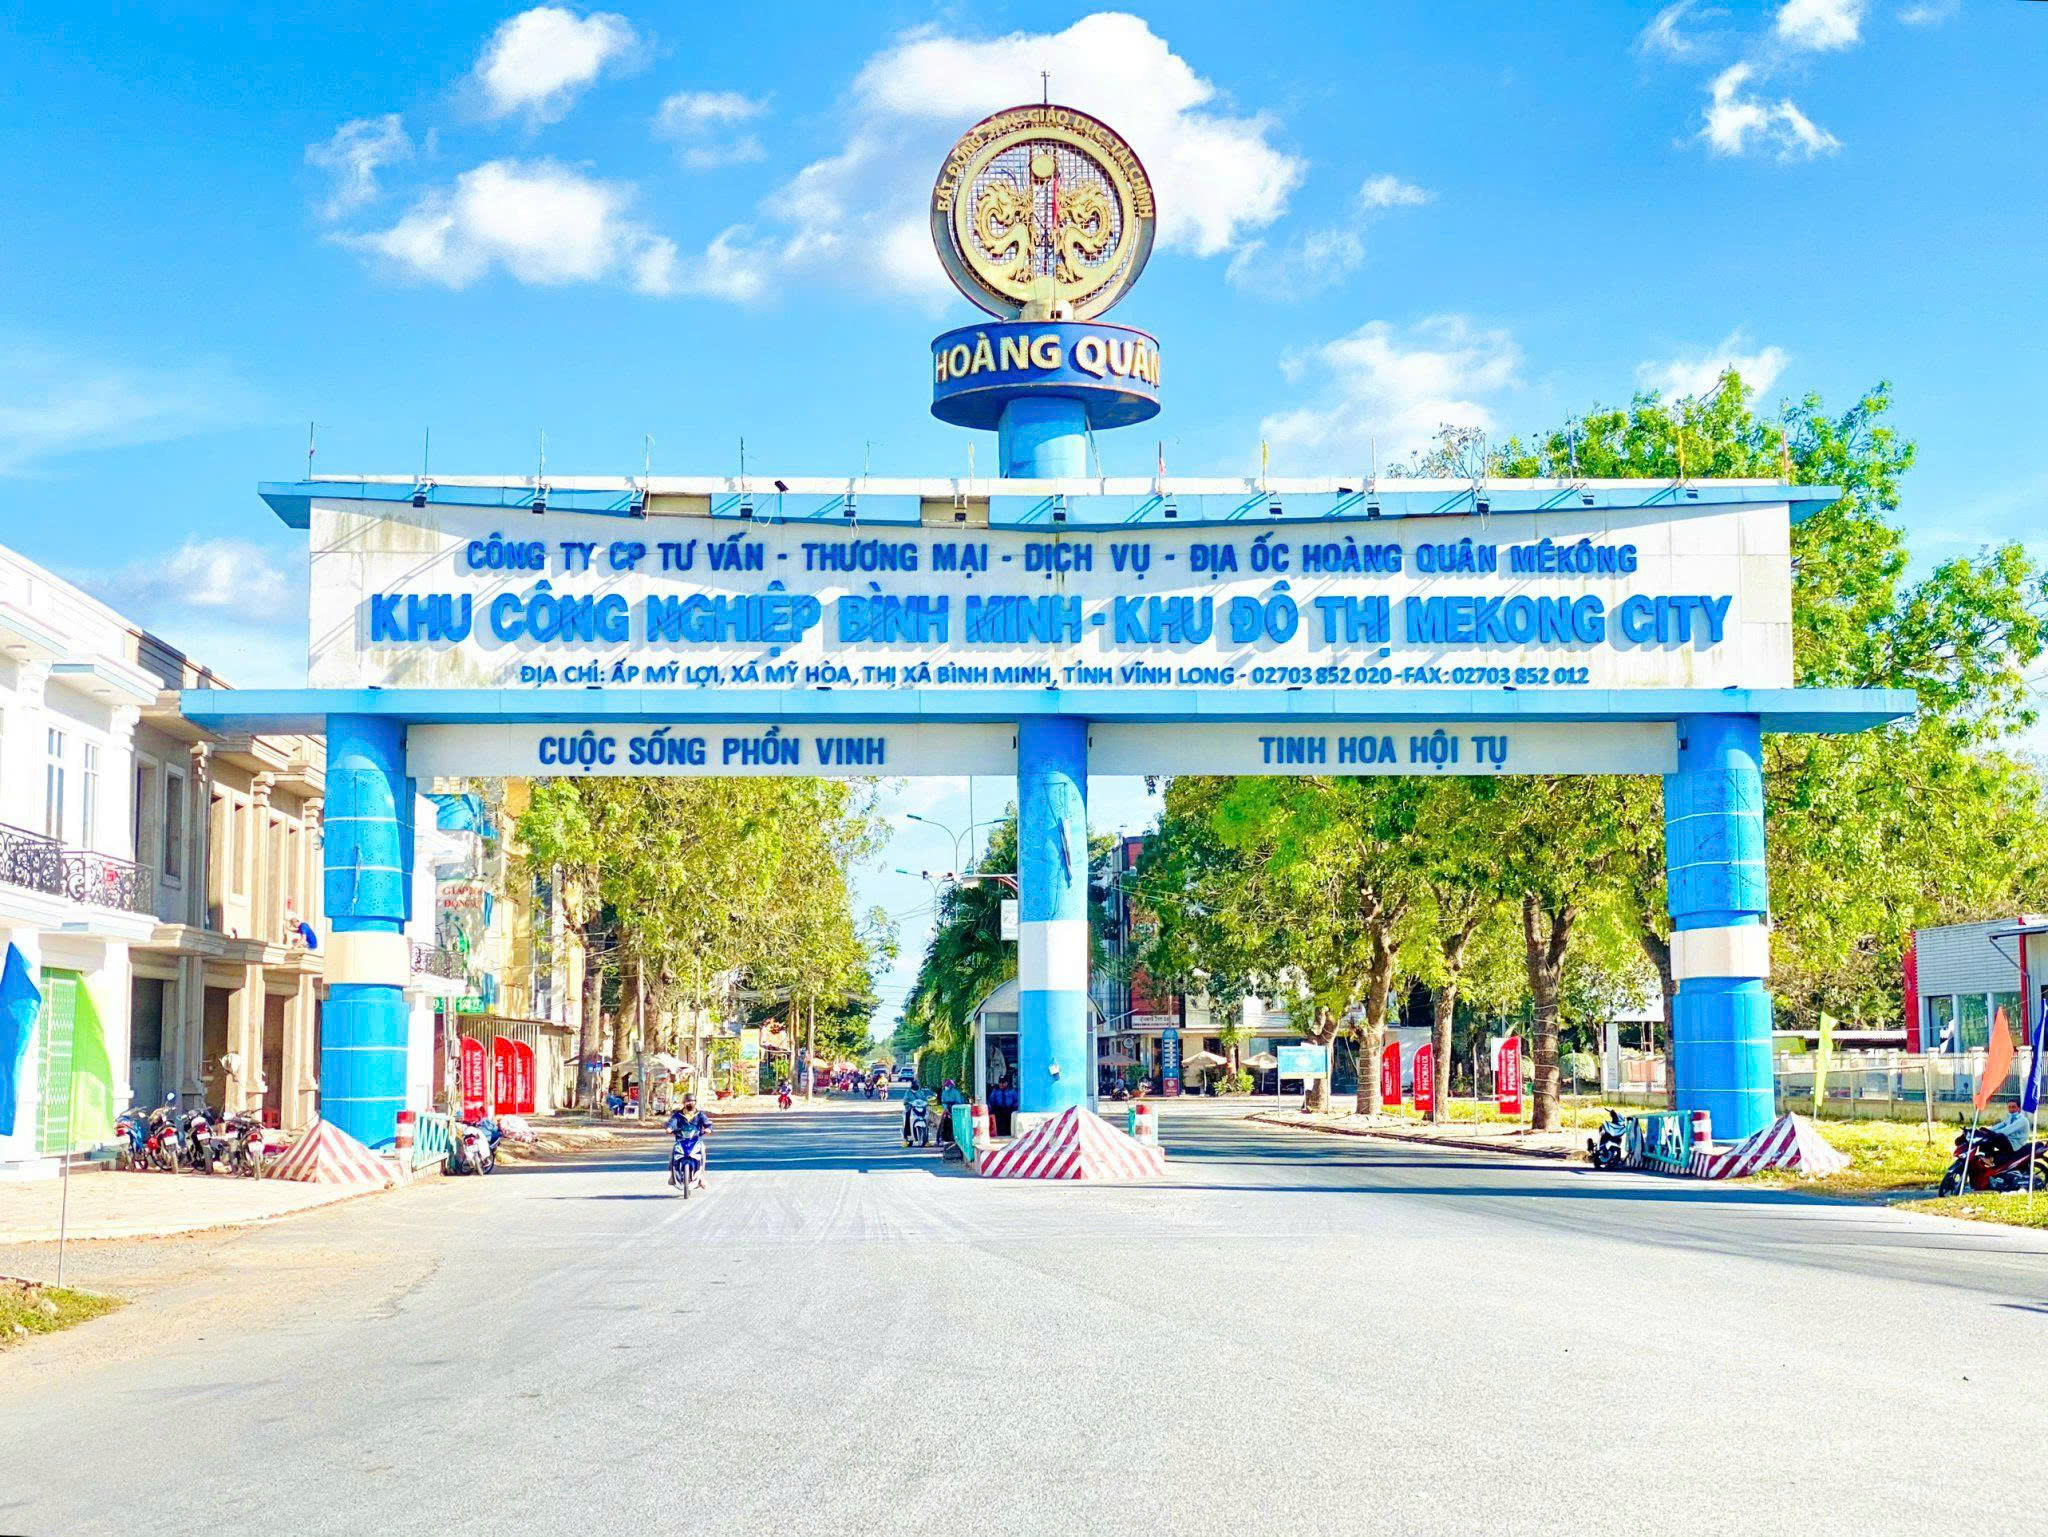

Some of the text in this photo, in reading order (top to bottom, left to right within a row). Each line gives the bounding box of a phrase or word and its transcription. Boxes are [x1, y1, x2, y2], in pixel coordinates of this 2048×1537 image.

[935, 331, 1160, 387] HOÀNG QUÂN
[467, 532, 546, 571] CÔNG
[560, 542, 597, 571] TY
[609, 541, 646, 571] CP
[657, 539, 697, 571] TƯ
[707, 532, 765, 572] VẤN
[801, 543, 919, 574] THƯƠNG
[932, 543, 989, 580] MẠI
[1024, 542, 1093, 580] DỊCH
[1110, 543, 1151, 580] VỤ
[1190, 543, 1239, 581] ĐỊA
[1250, 531, 1290, 573] ỐC
[1302, 535, 1403, 573] HOÀNG
[1416, 537, 1498, 574] QUÂN
[1511, 537, 1638, 573] MÊKÔNG
[371, 594, 473, 643] KHU
[489, 580, 631, 643] CÔNG
[646, 580, 822, 656] NGHIỆP
[839, 581, 950, 644] BÌNH
[965, 594, 1083, 644] MINH
[1114, 595, 1213, 644] KHU
[1229, 580, 1299, 643] ĐÔ
[1315, 595, 1391, 657] THỊ
[1406, 594, 1606, 643] MEKONG
[1621, 594, 1732, 643] CITY
[520, 665, 557, 688] ĐỊA
[611, 657, 640, 682] ẤP
[646, 661, 679, 682] MỸ
[687, 664, 725, 688] LỢI,
[731, 660, 759, 682] XÃ
[765, 660, 799, 682] MỸ
[805, 660, 859, 685] HÒA,
[863, 666, 896, 688] THỊ
[903, 661, 932, 682] XÃ
[938, 661, 988, 683] BÌNH
[1063, 660, 1112, 684] TỈNH
[1120, 661, 1171, 684] VĨNH
[1179, 667, 1235, 684] LONG
[1251, 667, 1313, 684] 02703
[1315, 667, 1351, 684] 852
[1452, 667, 1510, 684] 02703
[1514, 667, 1549, 684] 852
[1553, 667, 1589, 684] 012
[539, 729, 616, 771] CUỘC
[628, 726, 706, 765] SỐNG
[815, 738, 885, 765] VINH
[1258, 728, 1508, 770] TINH HOA HỘI TỤ
[472, 1051, 482, 1097] PHOENIX
[1507, 1049, 1516, 1091] PHOENIX
